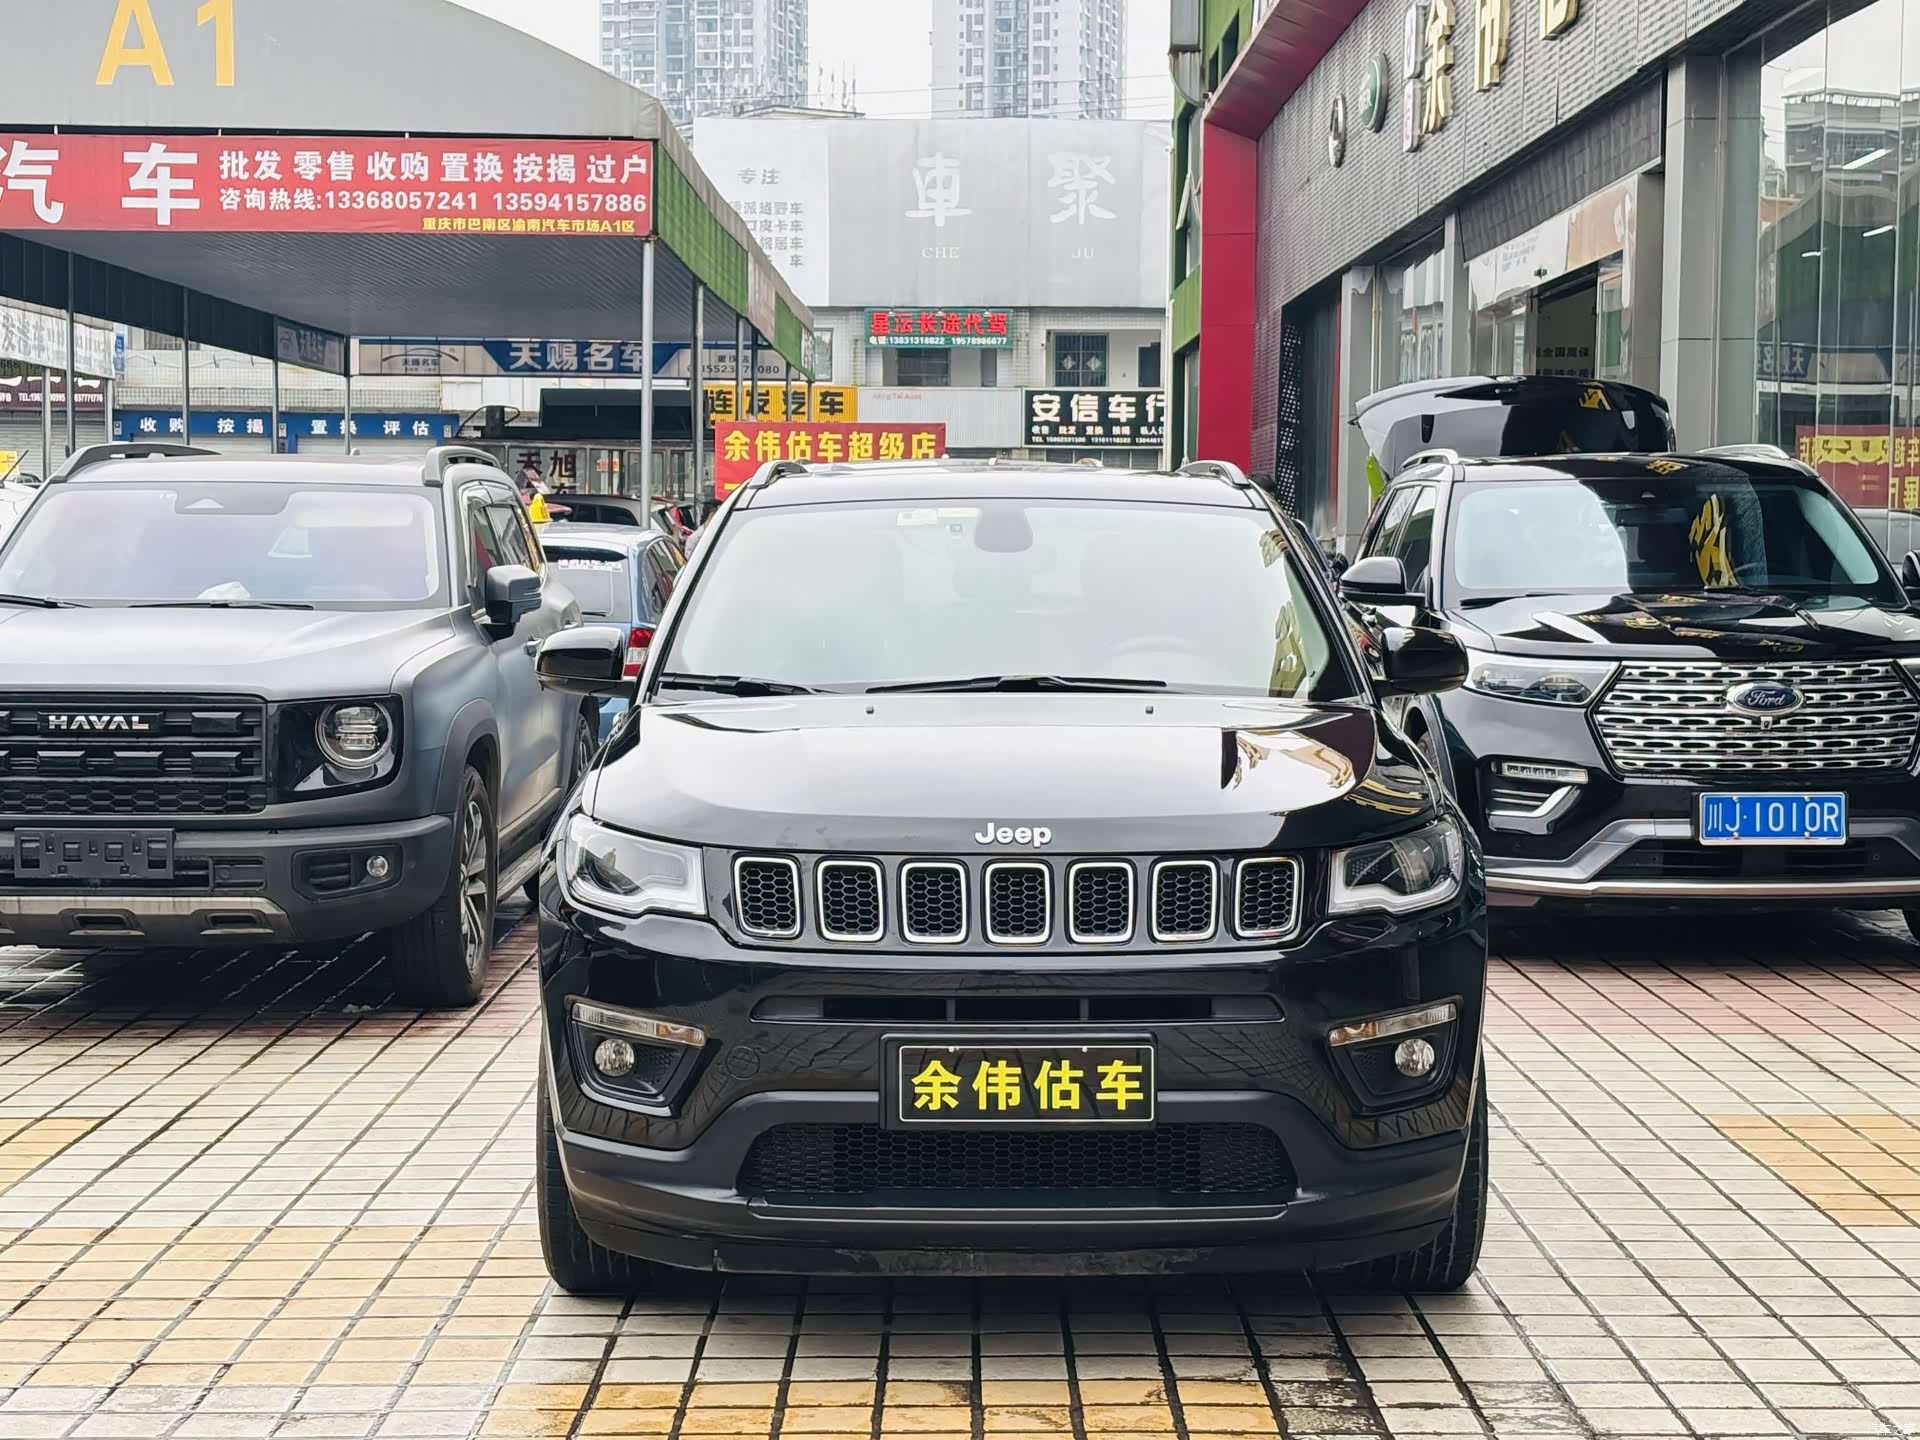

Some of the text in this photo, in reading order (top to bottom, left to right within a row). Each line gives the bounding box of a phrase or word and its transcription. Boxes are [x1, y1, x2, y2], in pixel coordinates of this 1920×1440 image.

[95, 0, 236, 87] A1
[219, 150, 648, 184] 批发 零售 收购 置换 按揭 过户
[738, 168, 781, 185] 专注
[219, 187, 647, 212] 咨询热线:13368057241 13594157886
[422, 217, 635, 233] 重庆市巴南区渝南汽车市场A1区
[921, 247, 960, 259] CHE
[509, 343, 643, 372] 天赐名车
[702, 364, 780, 374] 155237080
[1032, 393, 1164, 423] 安信车行
[140, 417, 430, 436] 收购 按揭 置换 评估
[723, 430, 937, 462] 余伟估车超级店
[1748, 689, 1787, 706] Ford
[49, 715, 150, 730] HAVAL
[1707, 802, 1839, 833] 川J·1010R
[975, 822, 1052, 848] Jeep
[911, 1060, 1144, 1111] 余伟估车
